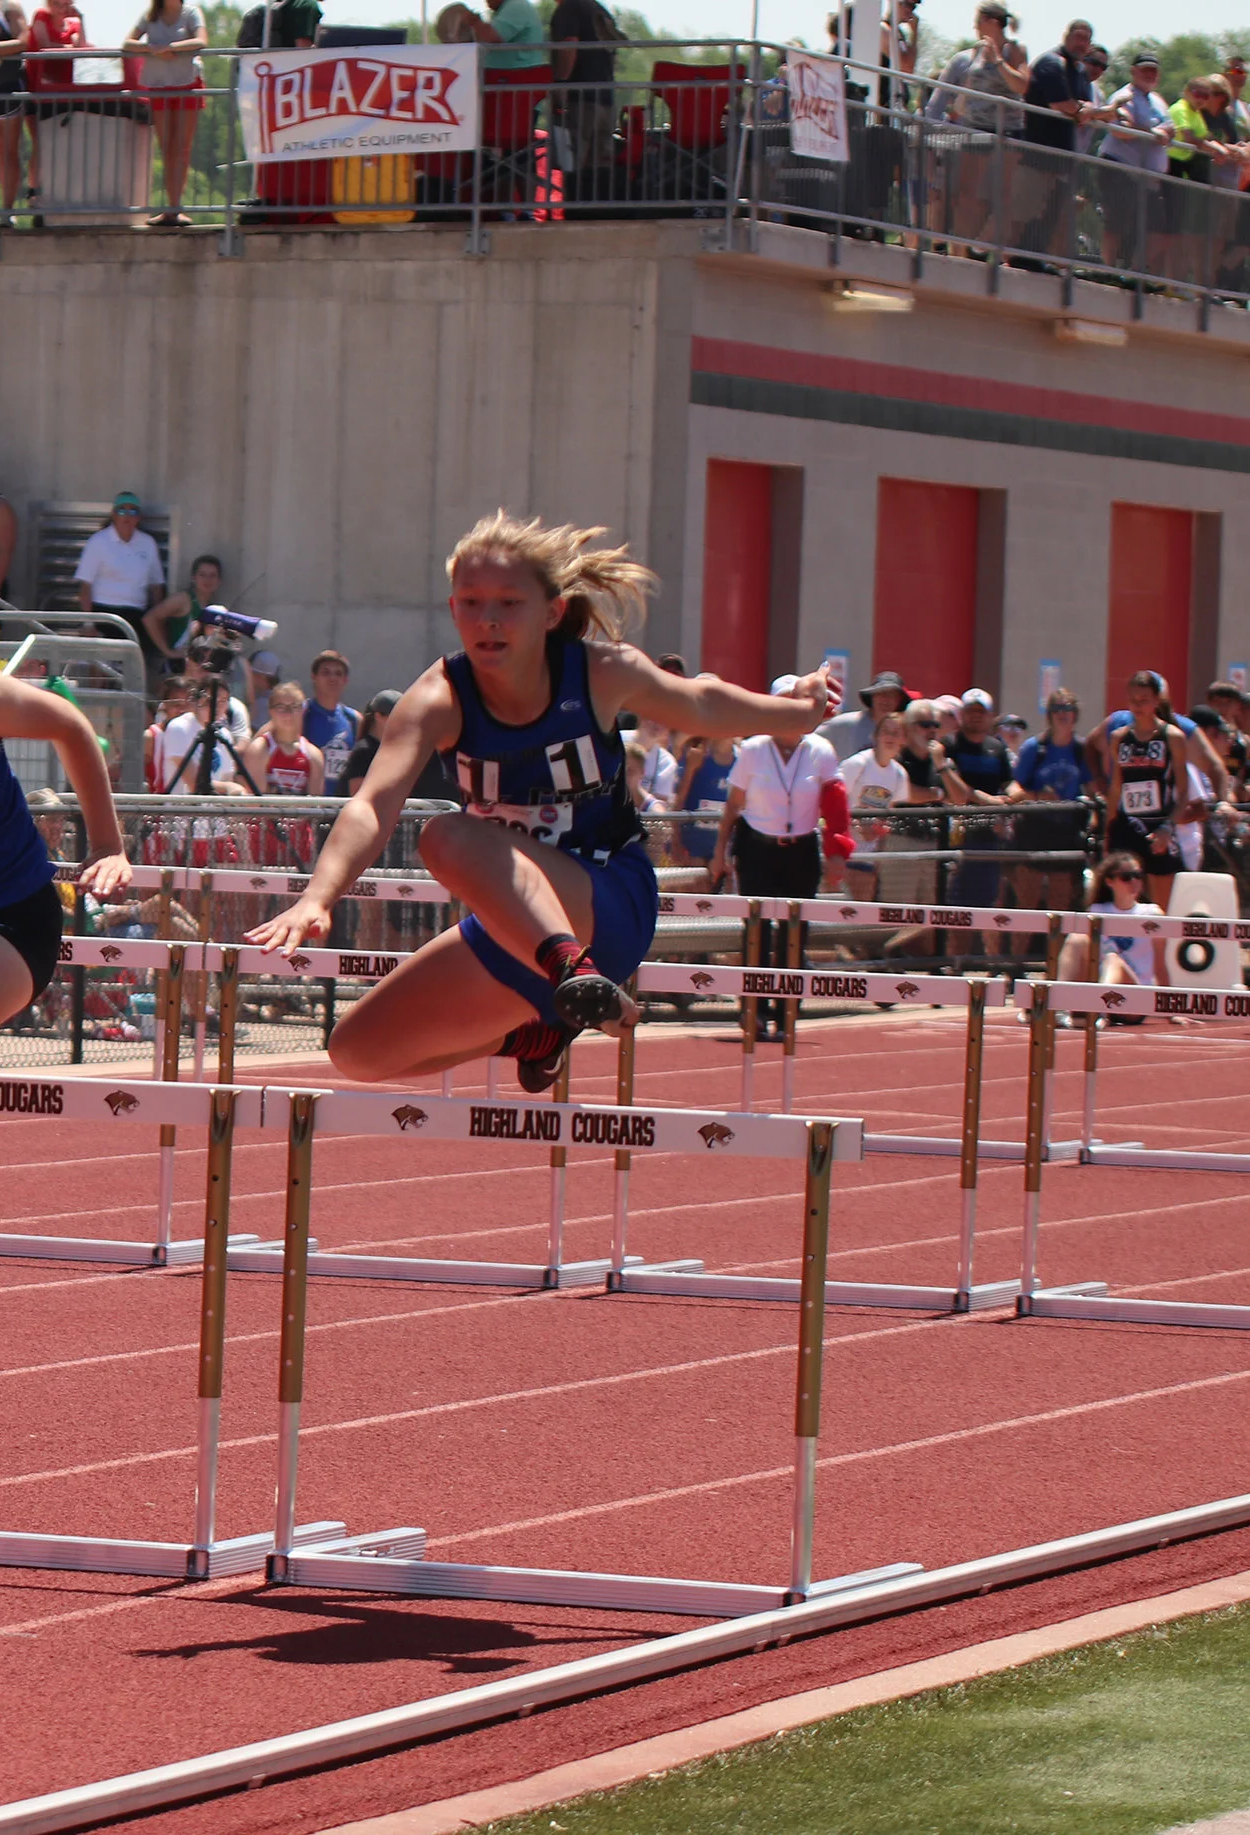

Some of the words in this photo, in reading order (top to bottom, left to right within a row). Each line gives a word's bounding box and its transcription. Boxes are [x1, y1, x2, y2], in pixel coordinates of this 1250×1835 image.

[274, 60, 451, 128] BLAZER
[282, 135, 354, 153] ATHLETIC
[359, 131, 452, 148] EQUIPMENT
[1149, 741, 1163, 760] 8
[550, 741, 601, 795] 1
[742, 972, 804, 995] HIGHLAND
[810, 975, 868, 998] COUGARS
[1154, 991, 1218, 1015] HIGHLAND
[469, 1106, 561, 1142] HIGHLAND
[571, 1112, 655, 1147] COUGARS
